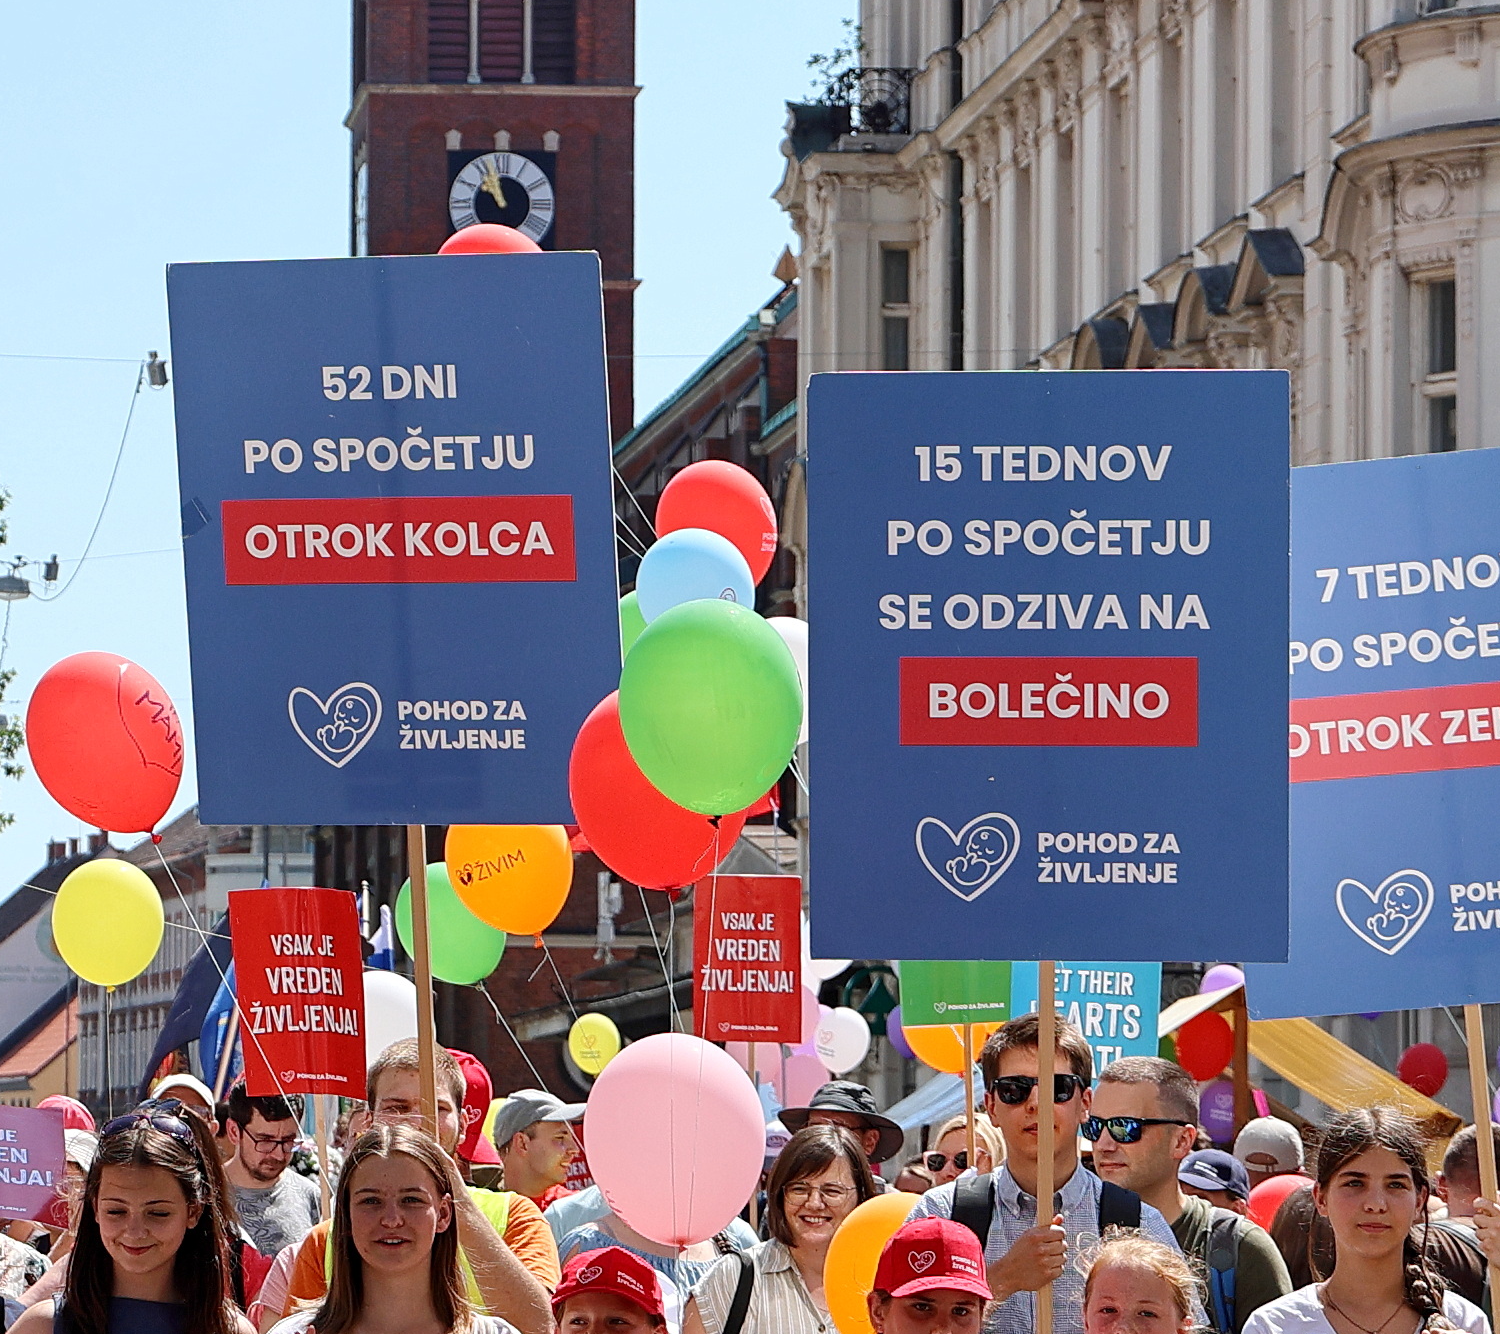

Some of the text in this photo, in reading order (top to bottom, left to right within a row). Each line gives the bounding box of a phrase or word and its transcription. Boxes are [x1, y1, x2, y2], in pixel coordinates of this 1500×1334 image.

[322, 365, 457, 401] 52 DNI
[244, 427, 535, 473] PO SPOČETJU
[914, 445, 1173, 481] 15 TEDNOV
[244, 520, 554, 560] OTROK KOLCA
[887, 509, 1212, 555] PO SPOČETJU
[1316, 569, 1336, 603] 7
[879, 594, 1211, 631] SE ODZIVA NA
[1290, 639, 1346, 675] PO
[398, 700, 527, 721] POHOD ZA
[929, 673, 1170, 720] BOLEČINO
[399, 725, 527, 750] ŽIVLJENJE
[1289, 713, 1432, 757] OTROK
[1037, 833, 1181, 853] POHOD ZA
[474, 848, 526, 881] ŽIVIM
[1038, 857, 1178, 884] ŽIVLJENJE
[721, 912, 775, 932] VSAK JE
[270, 934, 334, 957] VSAK JE
[715, 938, 780, 963] VREDEN
[265, 967, 343, 997] VREDEN
[701, 963, 794, 994] ŽIVLJENJA!
[1077, 970, 1134, 996] THEIR
[250, 999, 359, 1036] ŽIVLJENJA!
